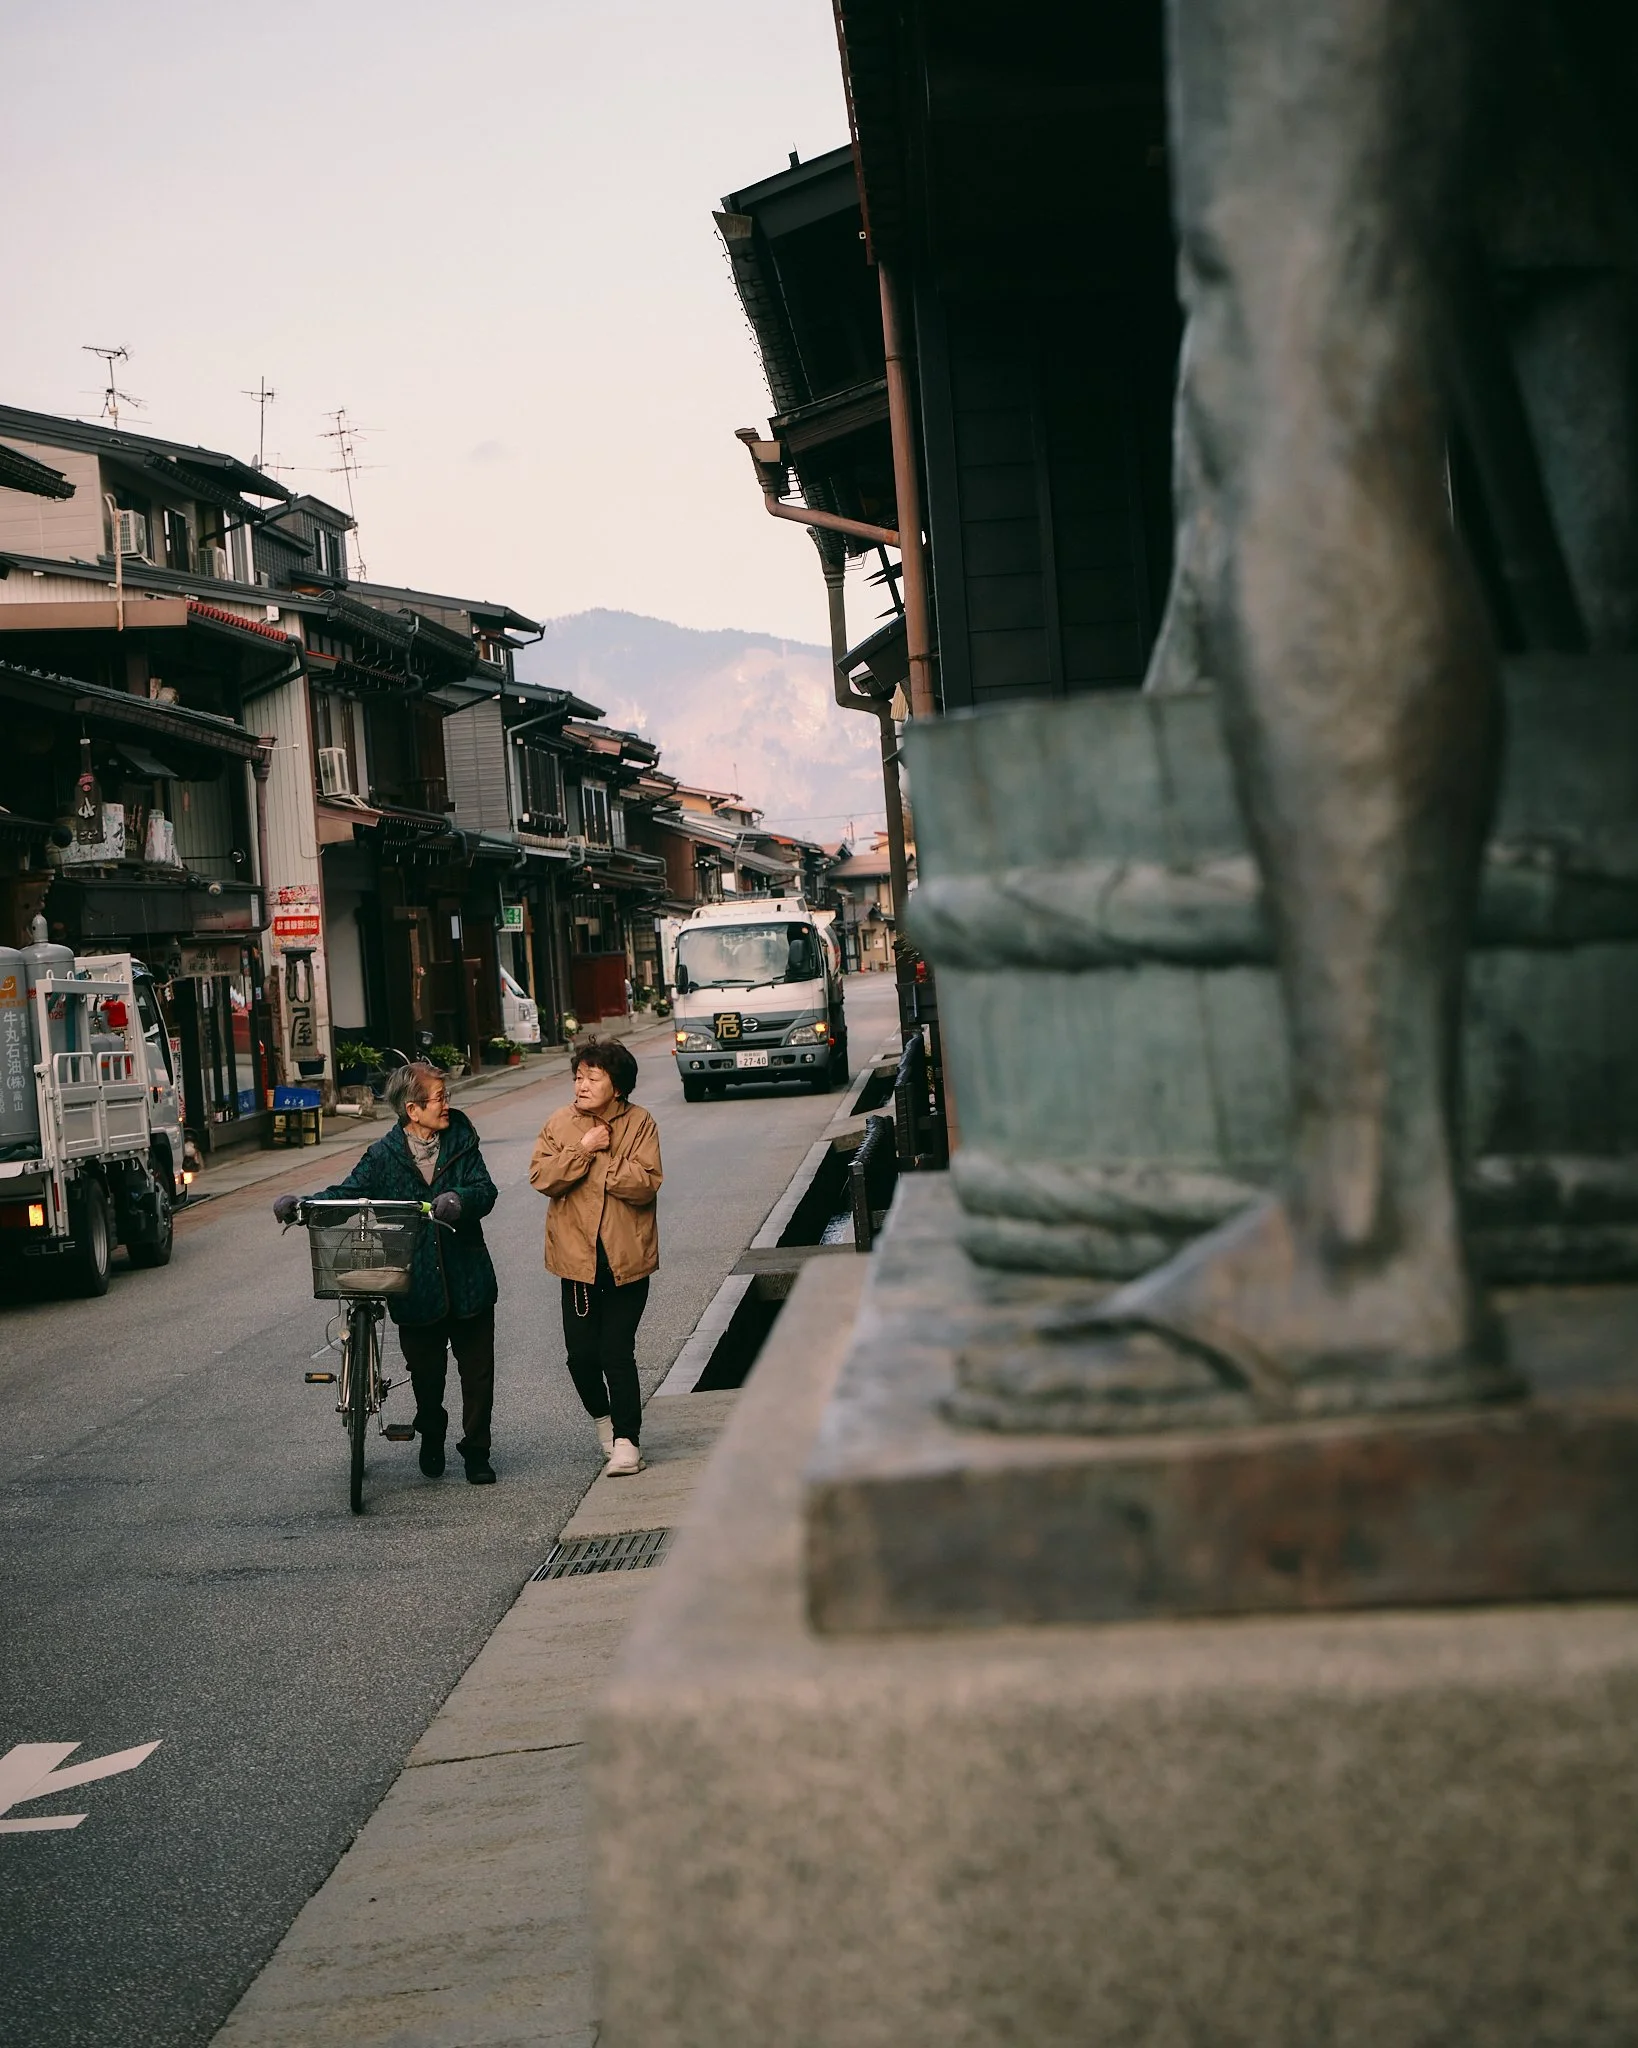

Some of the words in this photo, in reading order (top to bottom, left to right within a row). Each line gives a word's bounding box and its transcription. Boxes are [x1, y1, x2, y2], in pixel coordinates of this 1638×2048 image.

[715, 1013, 740, 1039] 危
[743, 1057, 767, 1067] 27-40
[24, 1241, 76, 1256] ELF
